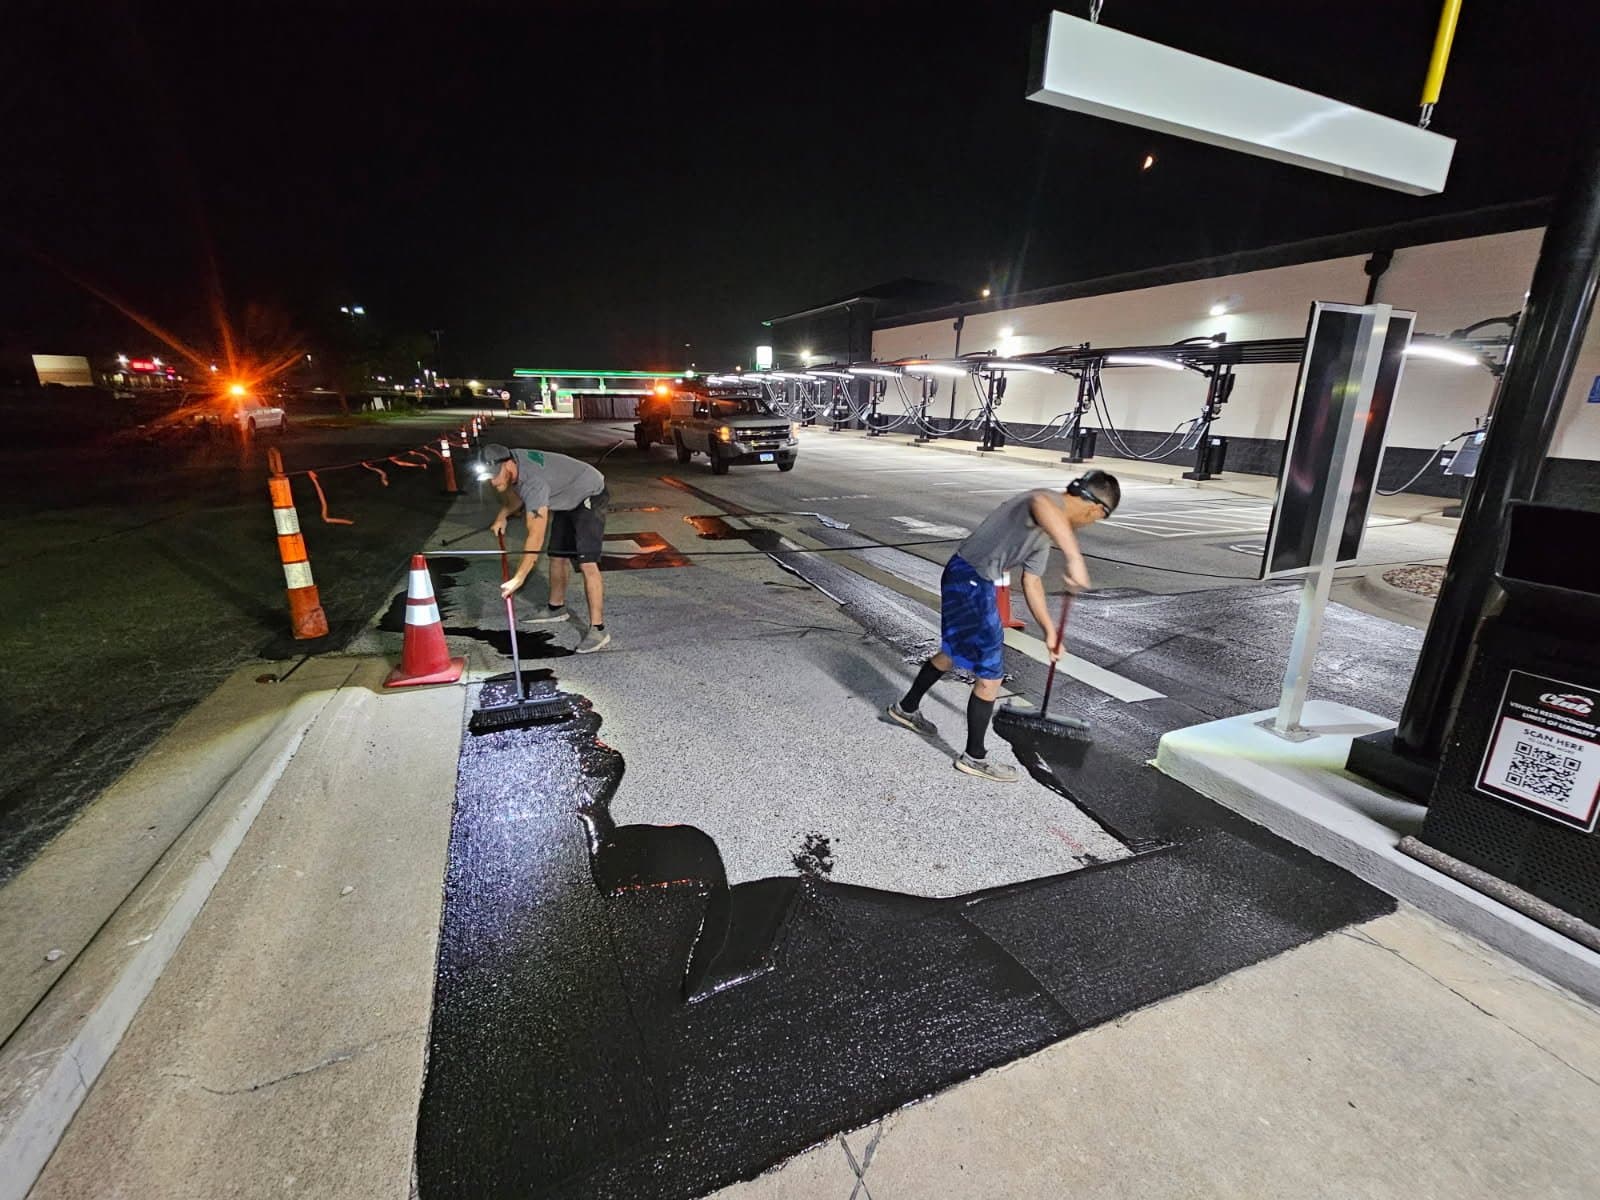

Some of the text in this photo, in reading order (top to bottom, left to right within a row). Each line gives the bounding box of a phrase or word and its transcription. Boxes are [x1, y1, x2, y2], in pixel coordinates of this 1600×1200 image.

[1547, 719, 1558, 727] OF
[1523, 728, 1553, 742] SCAN
[1556, 738, 1584, 752] HERE
